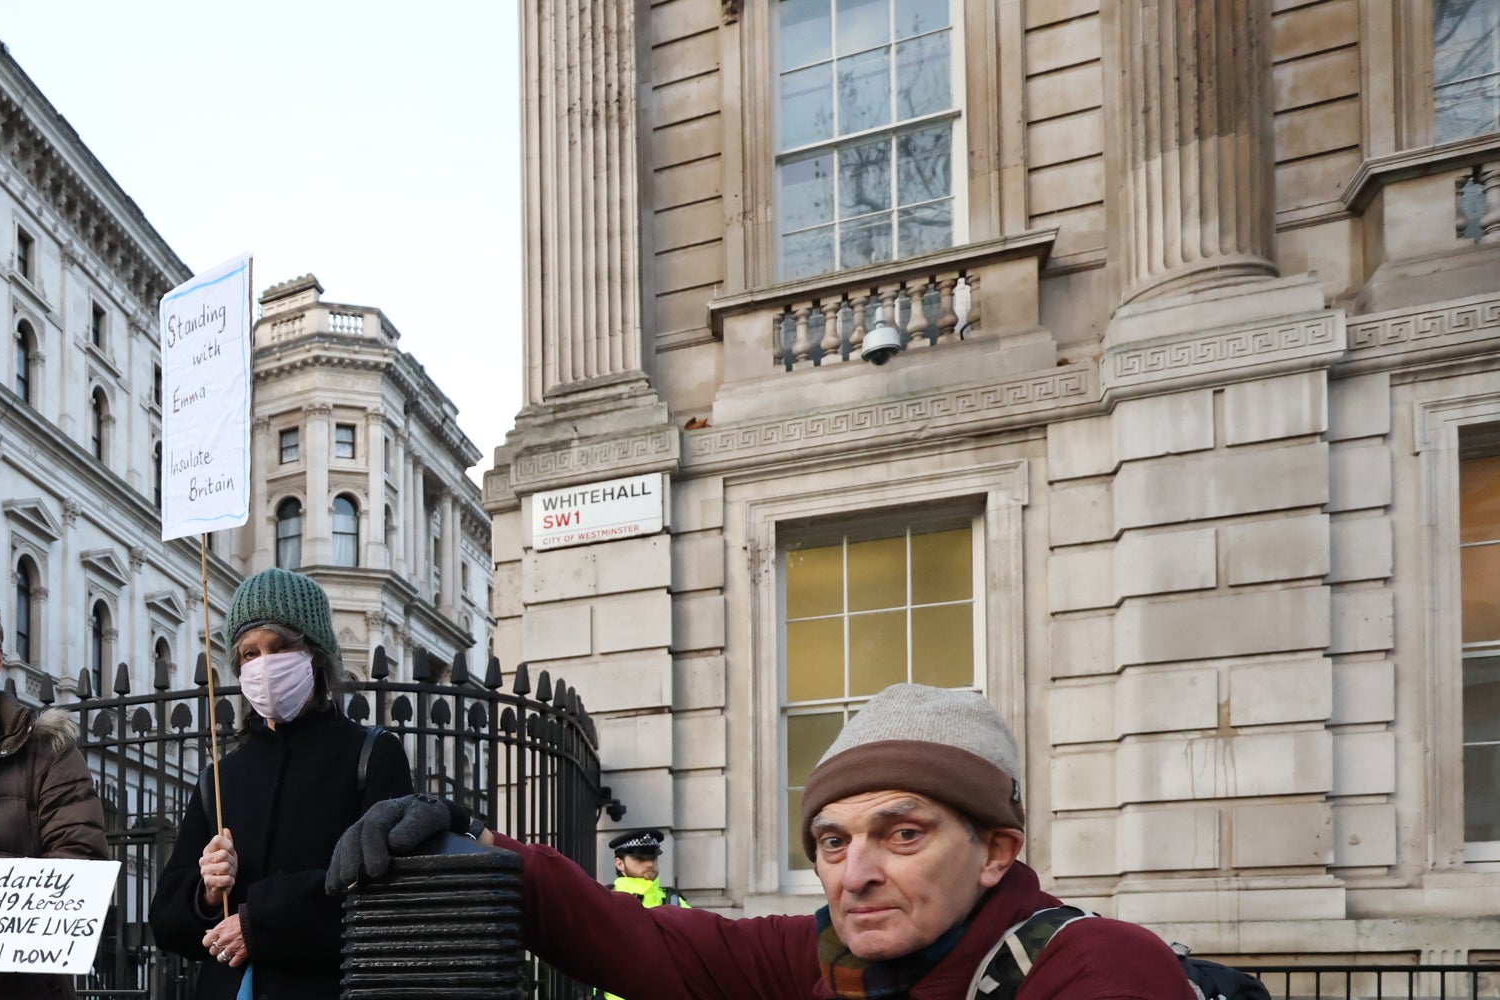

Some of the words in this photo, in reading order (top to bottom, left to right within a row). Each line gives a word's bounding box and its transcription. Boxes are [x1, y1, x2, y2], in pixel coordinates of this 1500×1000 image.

[167, 305, 227, 348] Standing
[192, 338, 221, 366] with
[173, 385, 206, 414] Emma
[170, 449, 213, 478] Insulate
[188, 473, 234, 502] Britain
[542, 482, 652, 511] WHITEHALL
[543, 511, 581, 529] SW1
[543, 536, 561, 545] CITY
[564, 534, 575, 543] OF
[578, 524, 640, 541] WESTMINSTER
[22, 892, 86, 912] heroes
[41, 917, 98, 937] LIVES
[11, 941, 76, 967] now!
